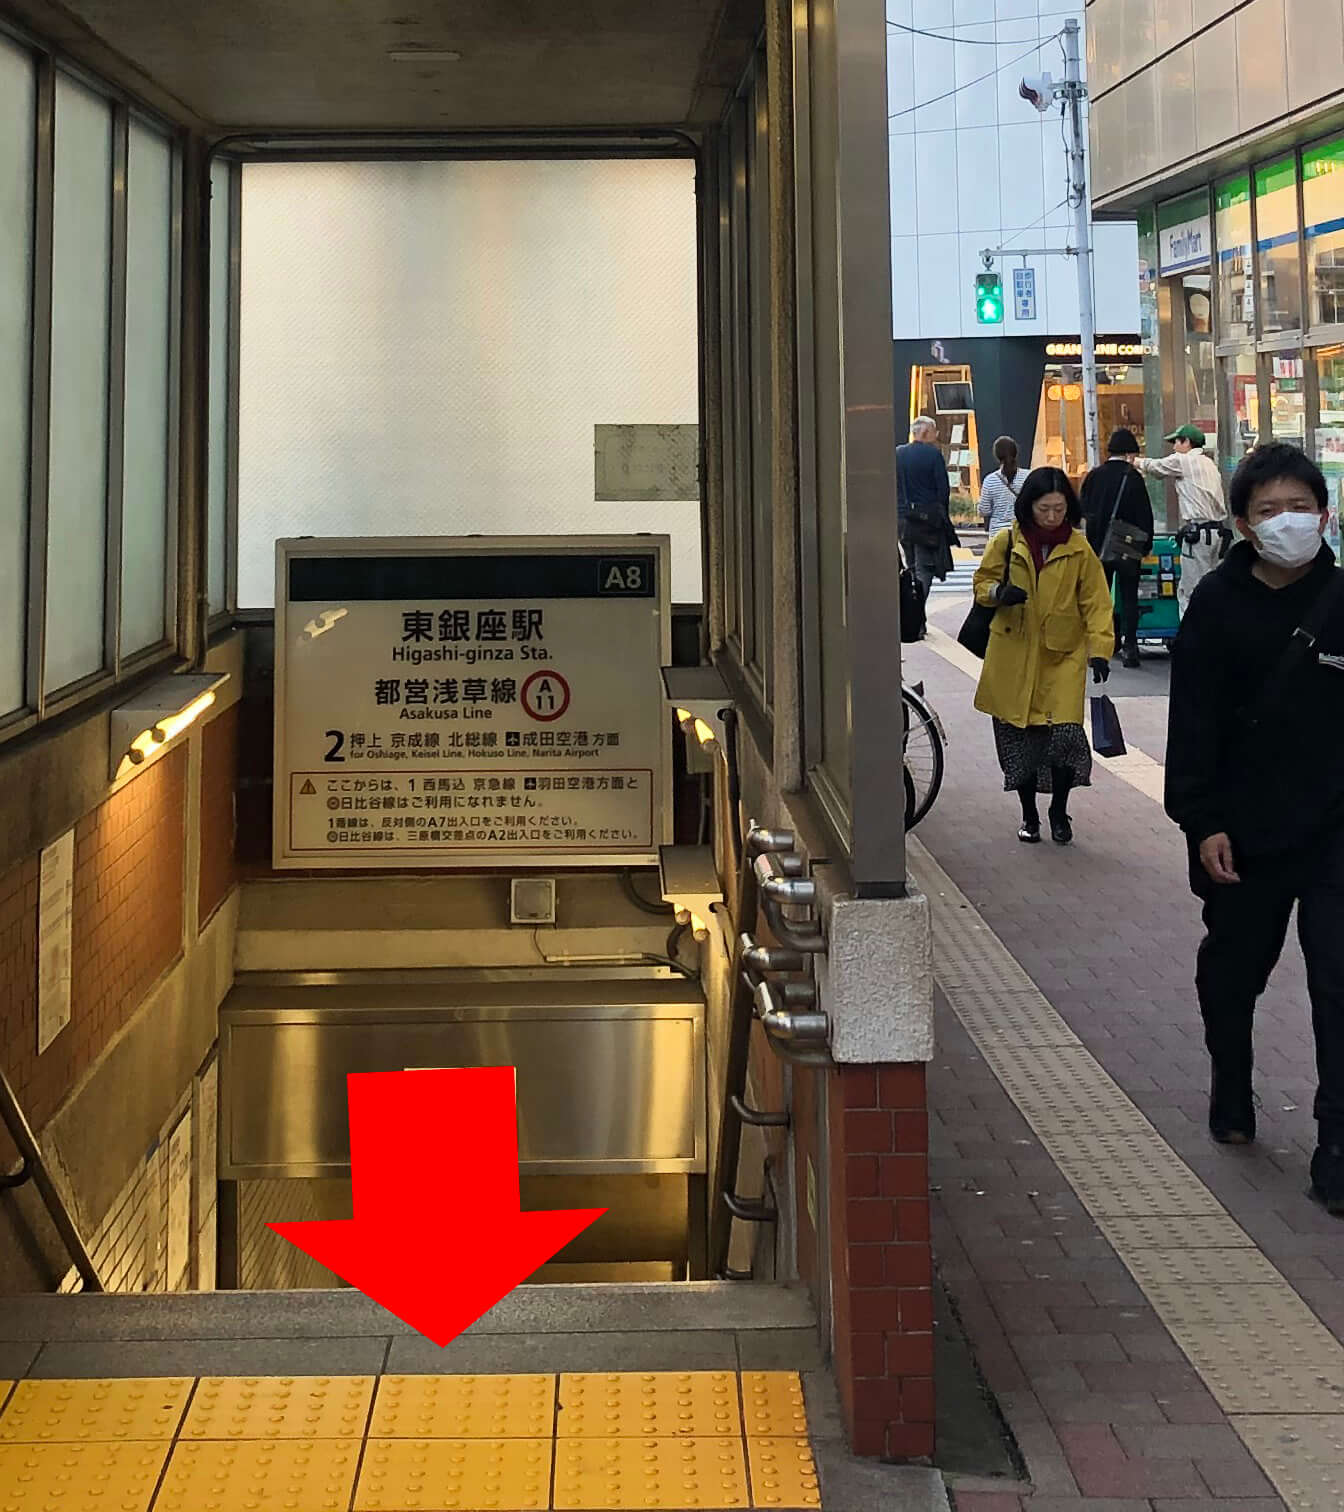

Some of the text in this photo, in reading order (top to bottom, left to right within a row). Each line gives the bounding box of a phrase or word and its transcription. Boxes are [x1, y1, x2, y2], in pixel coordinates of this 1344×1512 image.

[604, 565, 642, 589] A8
[401, 608, 544, 642] 東銀座駅
[392, 645, 553, 665] Higashi-ginza Sta.
[374, 678, 517, 705] 都営浅草線
[538, 678, 553, 694] A
[535, 695, 555, 710] 11
[399, 706, 493, 720] Asakusa Line
[324, 729, 346, 763] 2
[349, 732, 383, 749] 押上
[390, 732, 440, 748] 京成線
[448, 731, 498, 748] 北総線
[350, 749, 364, 759] for
[366, 749, 408, 760] Oshiage,
[411, 749, 440, 759] Keisei
[468, 748, 505, 758] Hokuso
[532, 748, 562, 758] Narita
[564, 748, 600, 759] Airport
[423, 777, 466, 791] 西馬込
[473, 777, 516, 791] 京急線
[537, 776, 639, 791] 羽田空港方面と
